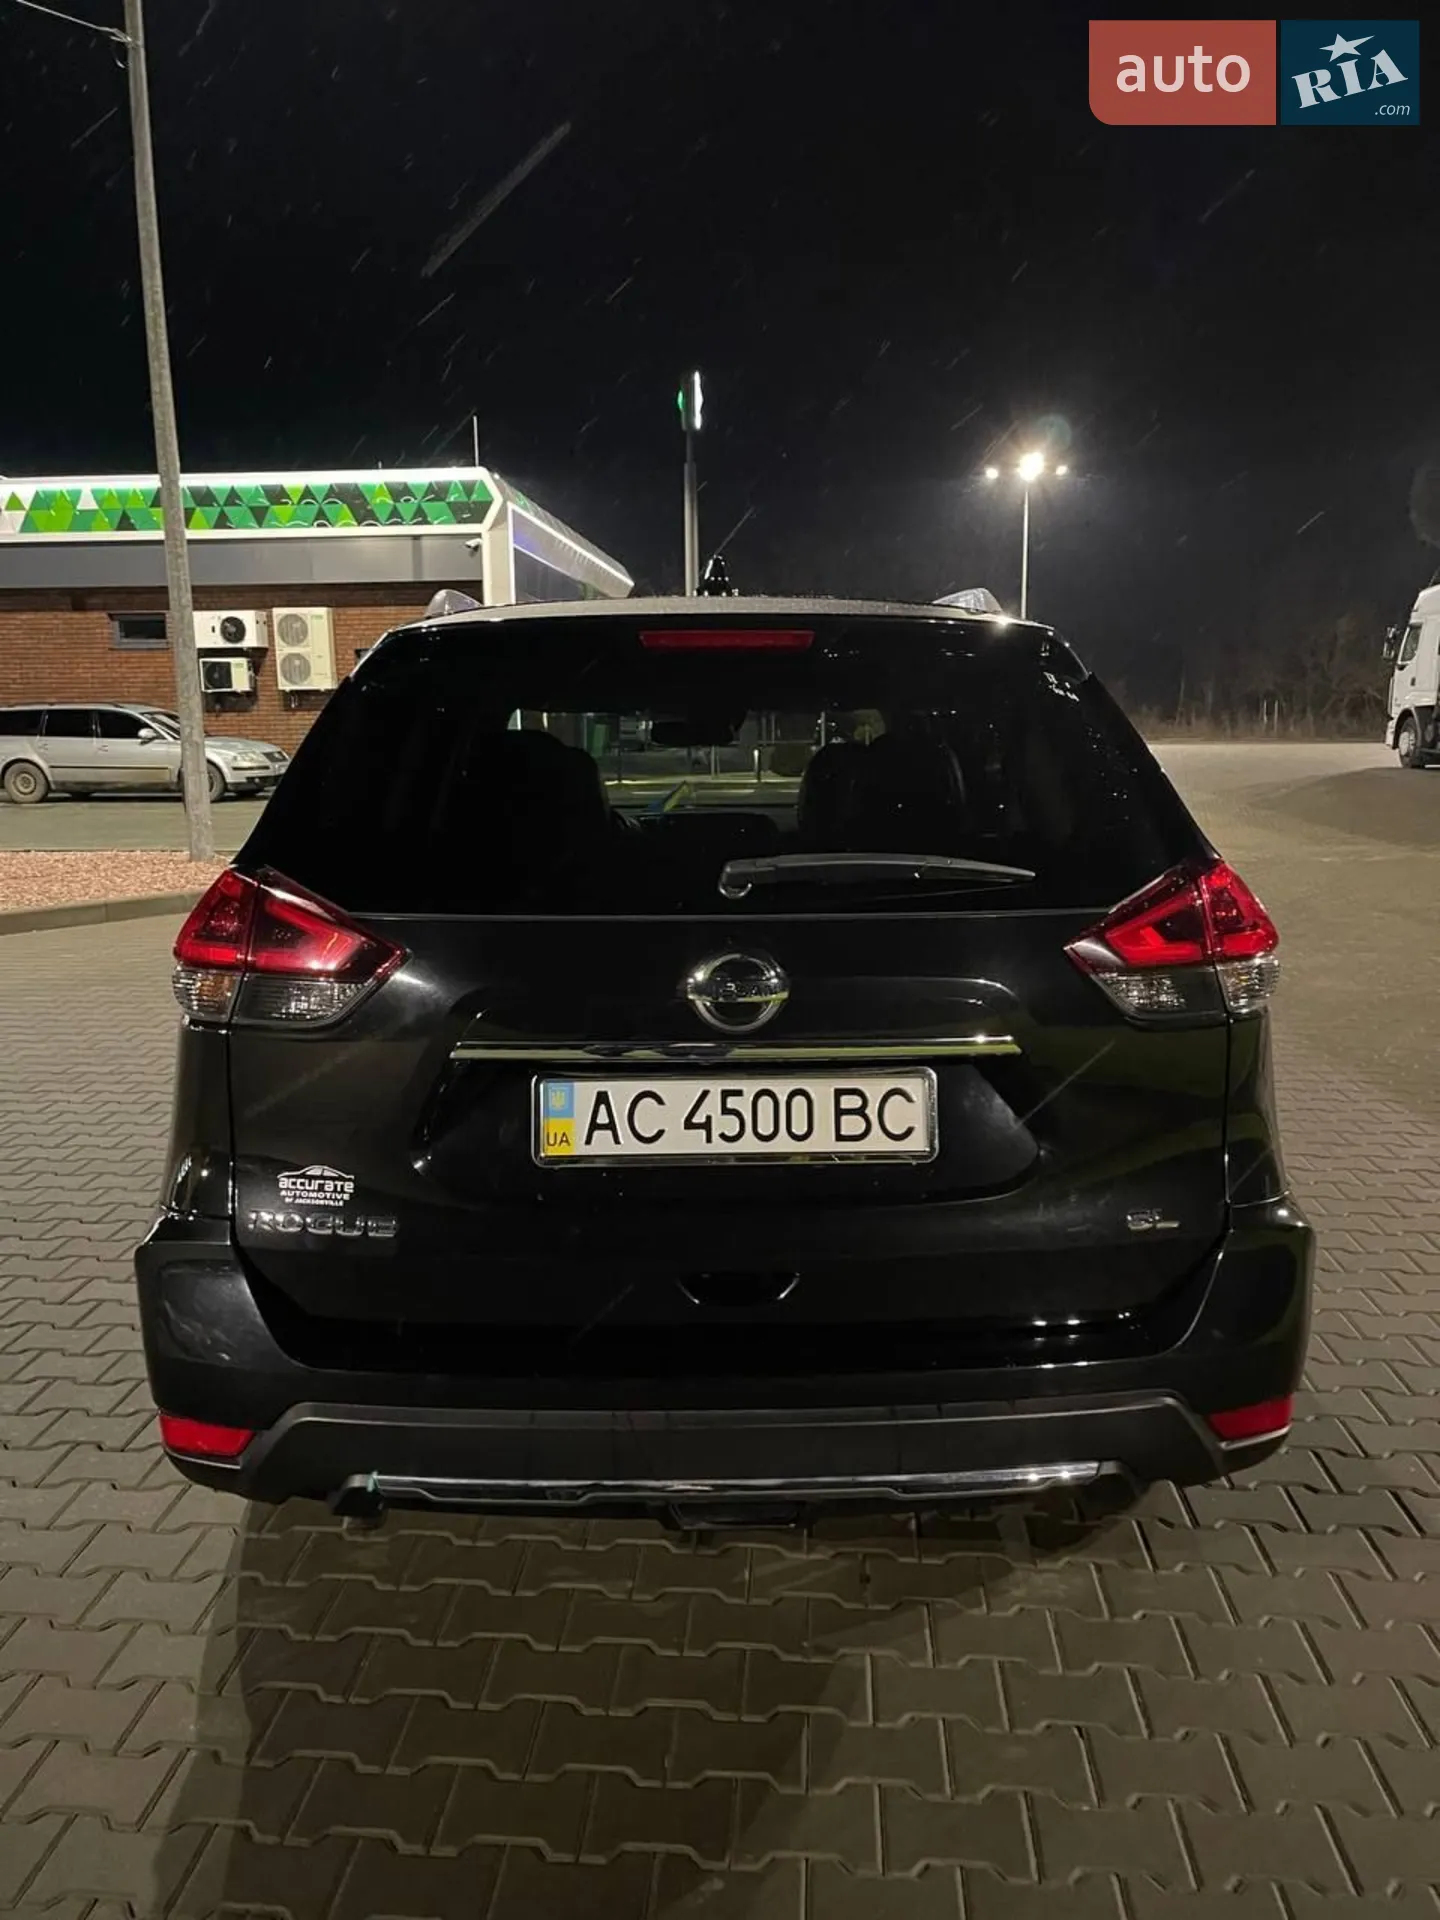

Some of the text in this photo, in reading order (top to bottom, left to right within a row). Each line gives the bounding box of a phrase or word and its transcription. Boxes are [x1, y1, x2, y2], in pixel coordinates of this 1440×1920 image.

[584, 1087, 916, 1145] AC 4500 BC
[546, 1132, 570, 1147] UA
[280, 1190, 350, 1200] AUTOMOTIVE
[248, 1209, 397, 1237] ROGUE
